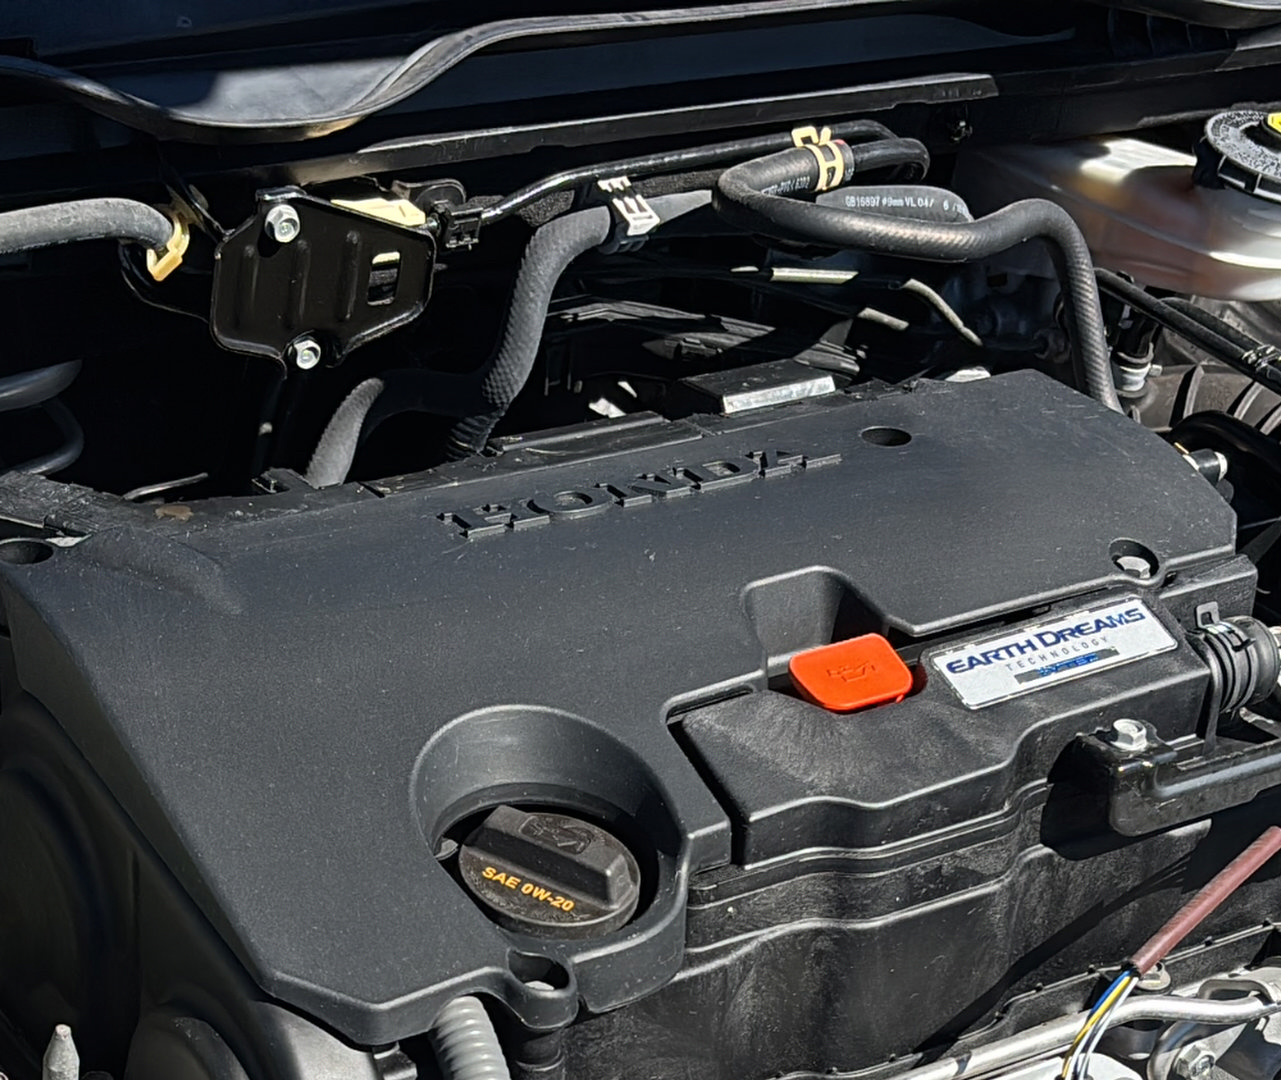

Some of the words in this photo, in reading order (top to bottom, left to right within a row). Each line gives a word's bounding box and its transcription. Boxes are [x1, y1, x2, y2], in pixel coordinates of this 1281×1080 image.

[436, 451, 842, 538] HONDA
[946, 638, 1038, 674] EARTH
[1035, 607, 1146, 649] DREAMS
[1005, 635, 1108, 671] TECHNOLOGY
[482, 866, 521, 889] SAE
[521, 883, 575, 911] 0W-20
